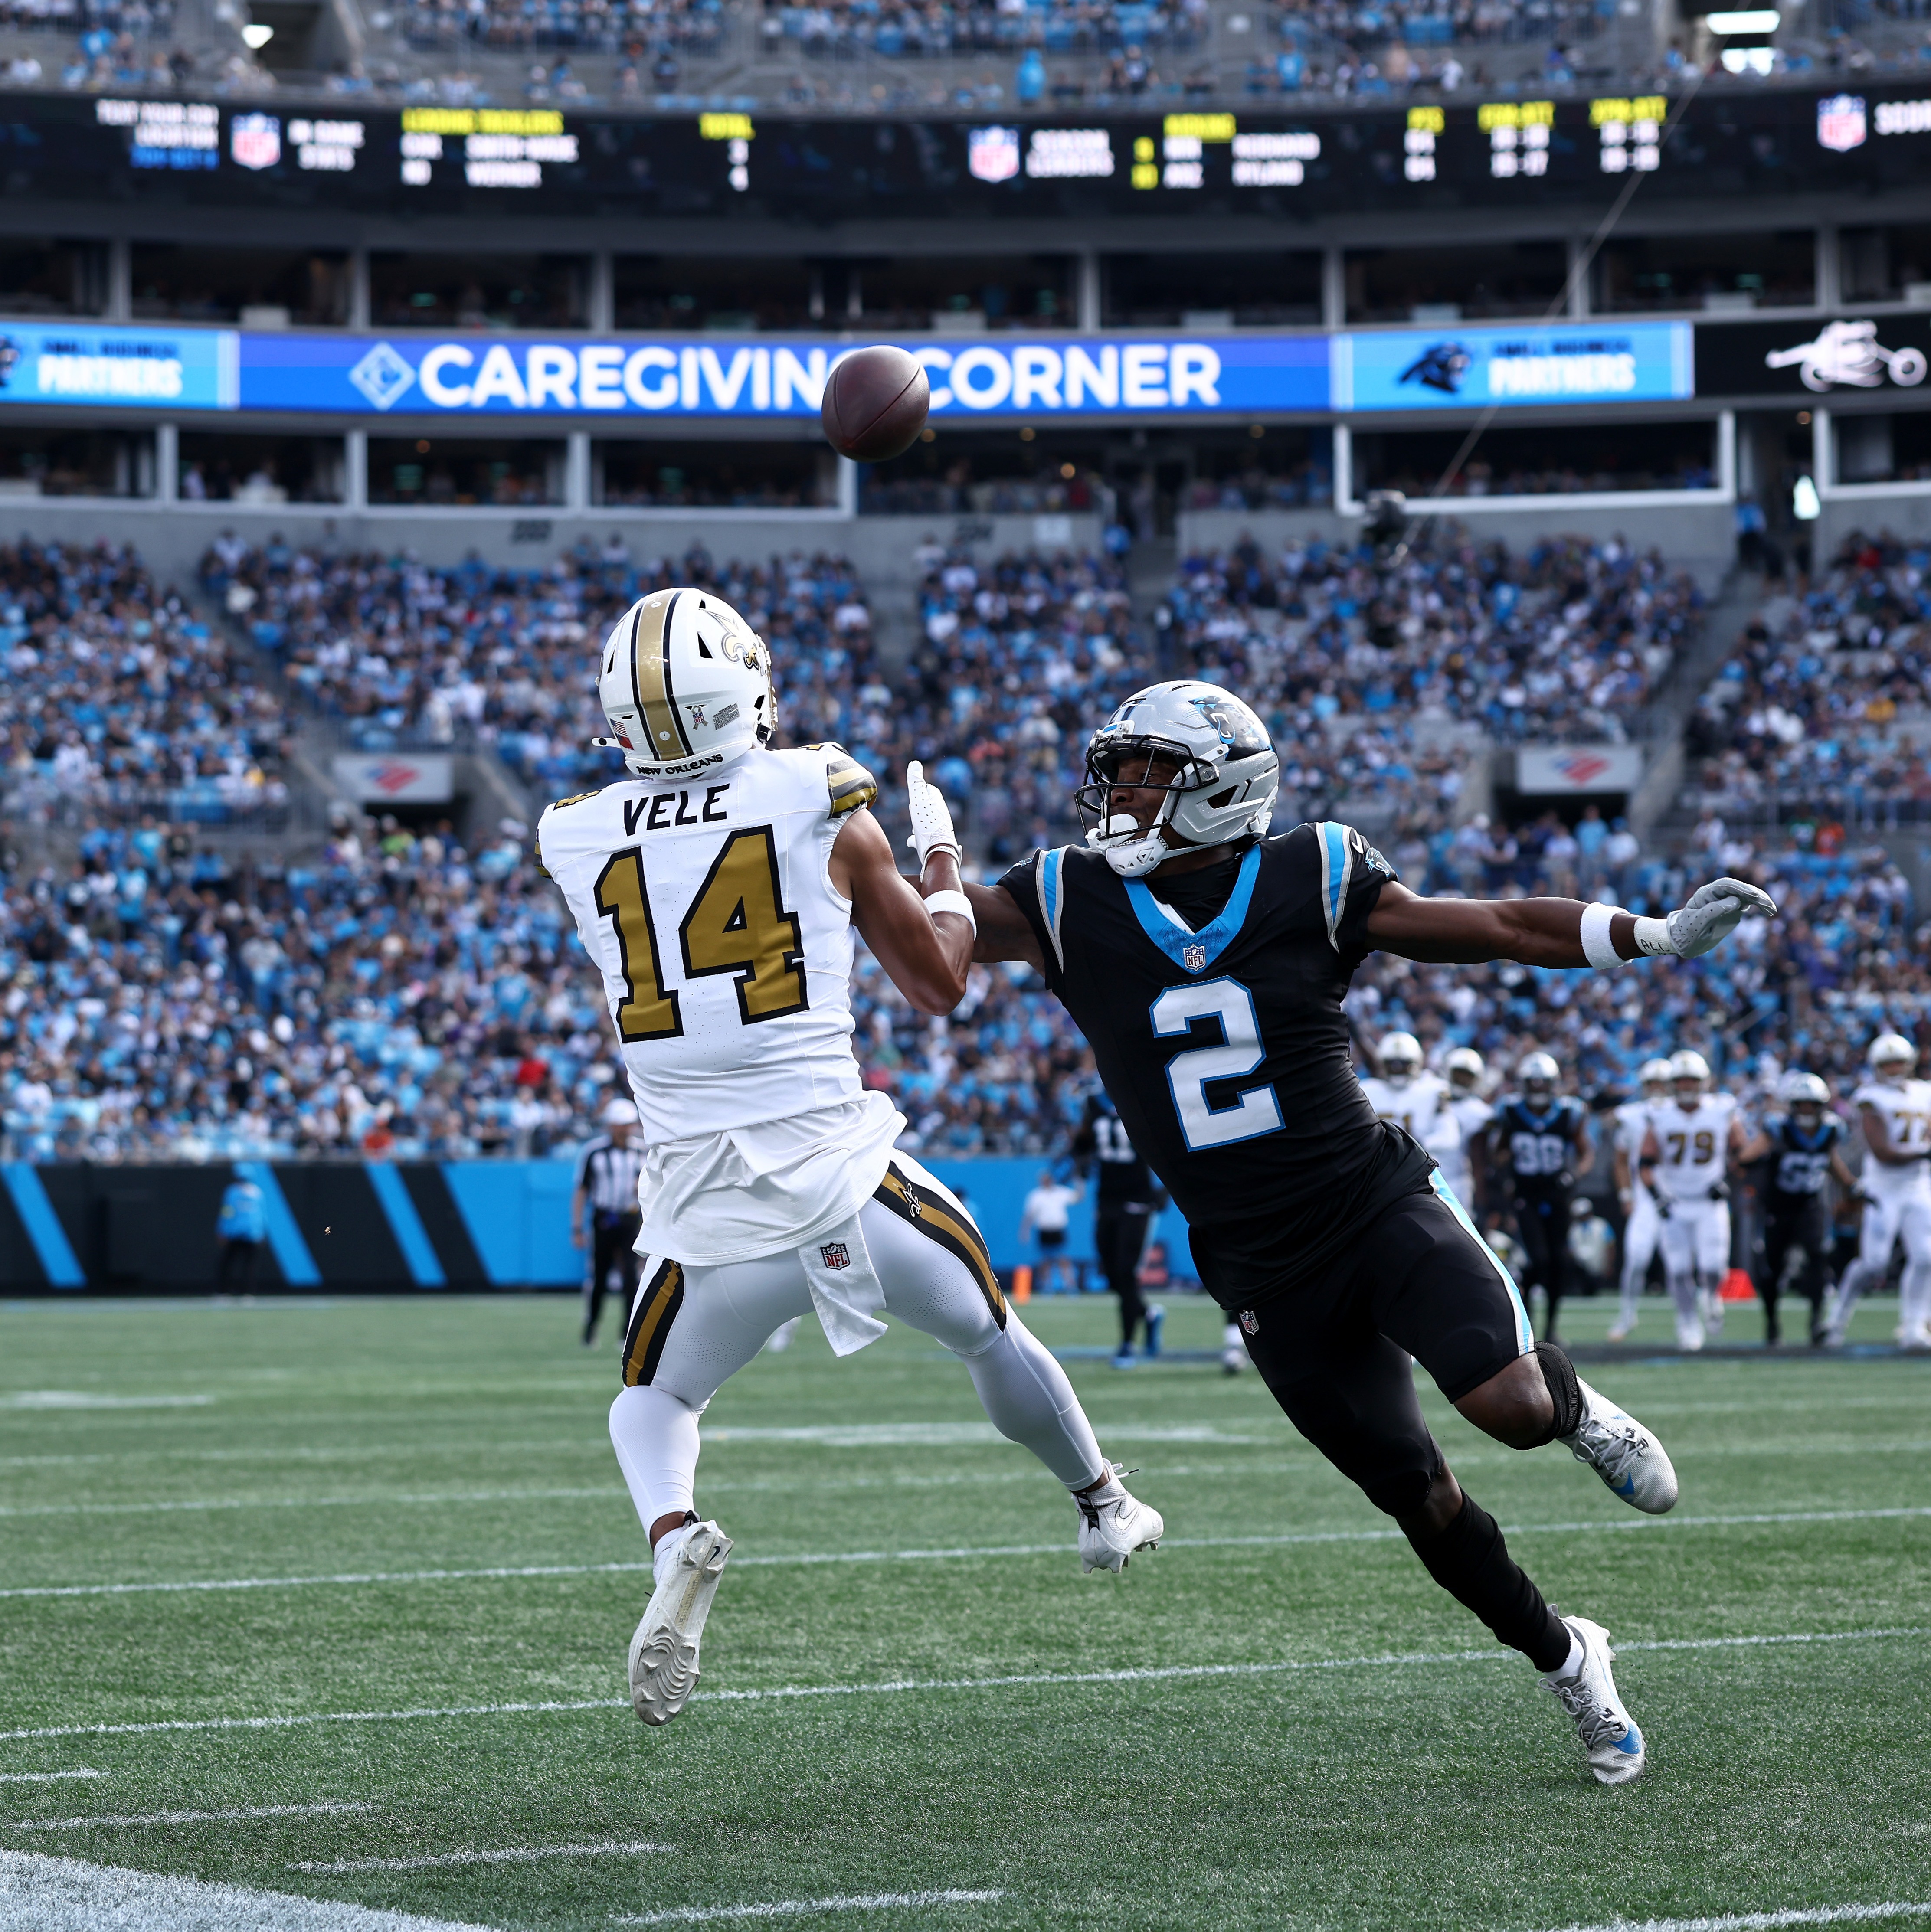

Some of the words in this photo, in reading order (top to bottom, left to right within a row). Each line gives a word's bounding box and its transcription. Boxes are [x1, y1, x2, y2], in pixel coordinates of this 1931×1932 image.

[418, 343, 861, 411] CAREGIVIN
[636, 765, 661, 775] NEW
[665, 753, 723, 775] ORLEANS
[624, 783, 730, 836] VELE
[593, 824, 810, 1043] 14
[1640, 939, 1671, 952] ALL
[1187, 955, 1203, 967] NFL
[1149, 975, 1286, 1153] 2
[1092, 1115, 1136, 1164] 11
[1666, 1129, 1715, 1167] 79
[825, 1253, 848, 1267] NFL
